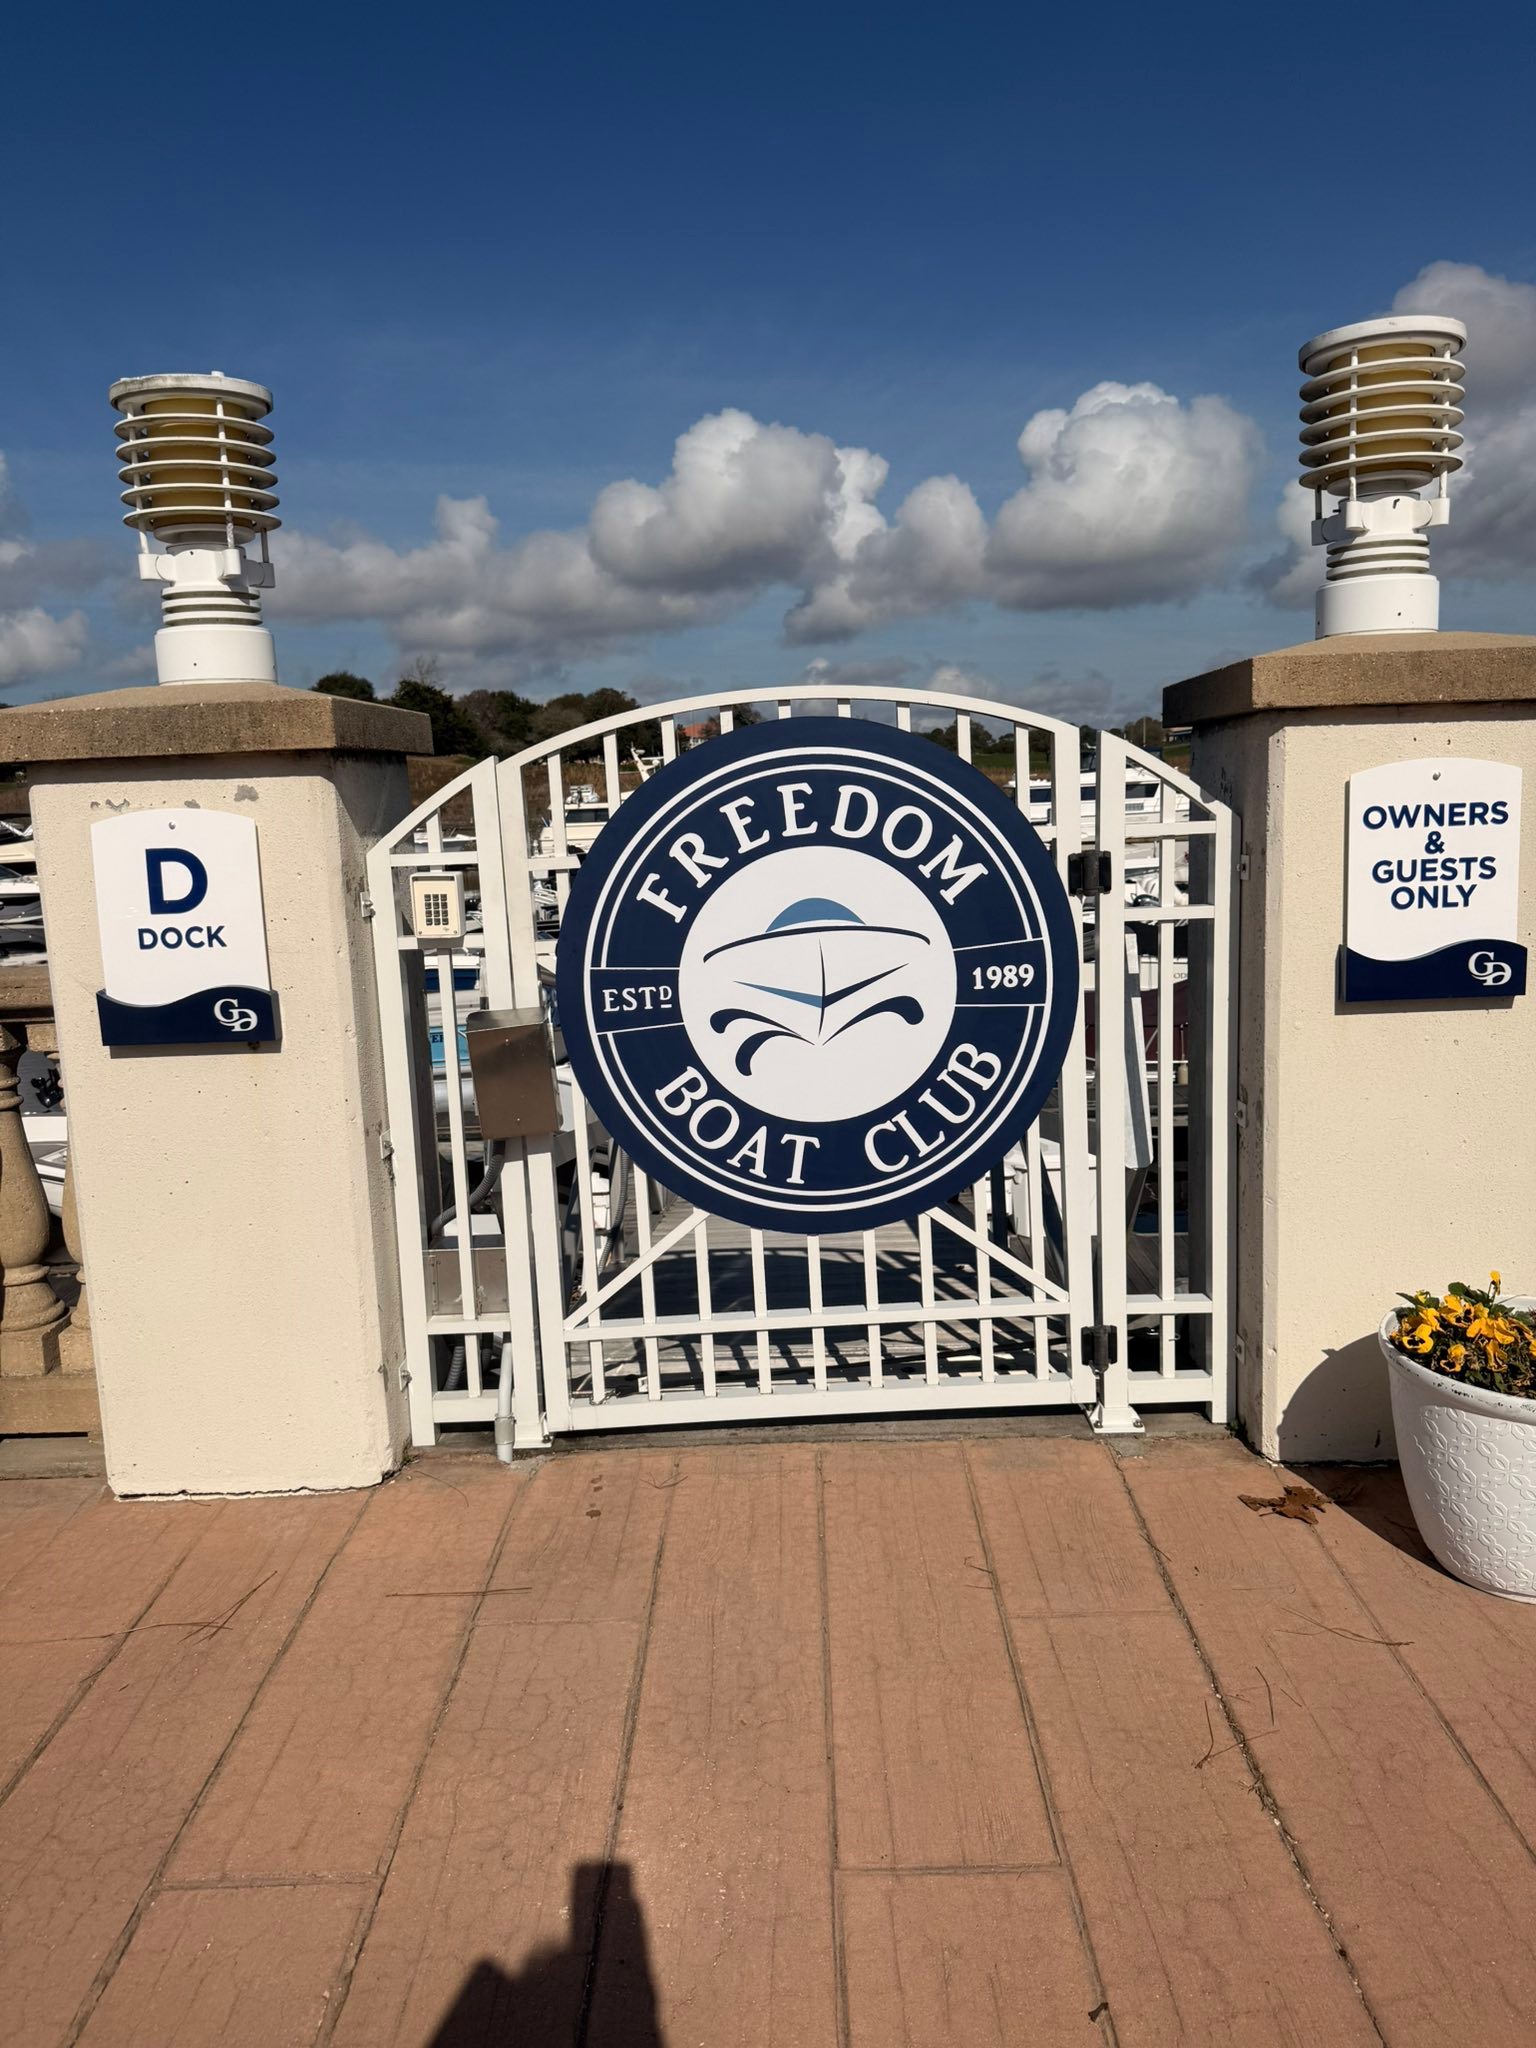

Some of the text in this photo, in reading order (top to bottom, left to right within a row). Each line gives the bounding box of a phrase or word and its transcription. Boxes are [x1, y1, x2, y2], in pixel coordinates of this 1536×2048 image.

[1363, 801, 1509, 830] OWNERS
[636, 782, 989, 923] FREEDOM
[1424, 831, 1445, 854] &
[145, 848, 208, 915] D
[1372, 856, 1497, 884] GUESTS
[1391, 884, 1477, 910] ONLY
[138, 926, 227, 950] DOCK
[972, 963, 1035, 990] 1989
[655, 1042, 1002, 1185] BOAT CLUB
